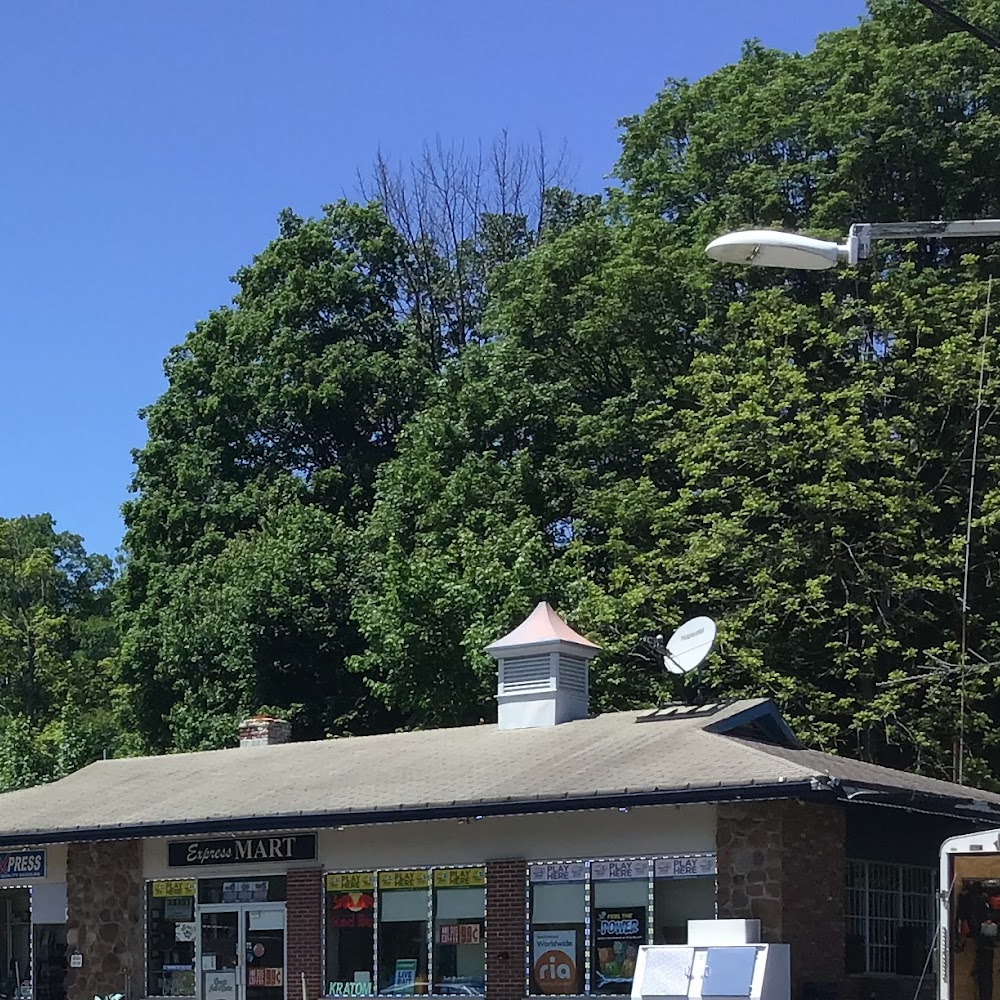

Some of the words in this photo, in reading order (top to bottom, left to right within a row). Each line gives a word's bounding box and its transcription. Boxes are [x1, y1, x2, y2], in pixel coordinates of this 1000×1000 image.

[186, 843, 232, 863] Express
[234, 837, 296, 860] MART
[609, 862, 633, 870] PLAY
[673, 859, 697, 867] PLAY
[547, 865, 570, 873] PLAY
[609, 869, 633, 877] HERE
[673, 866, 697, 874] HERE
[394, 872, 416, 880] PLAY
[449, 870, 471, 878] PLAY
[547, 871, 570, 880] HERE
[341, 881, 361, 889] HERE
[394, 879, 416, 887] HERE
[449, 877, 471, 885] HERE
[165, 882, 183, 890] PLAY
[600, 919, 639, 935] POWER
[540, 956, 571, 979] ria
[329, 981, 372, 995] KRATOM
